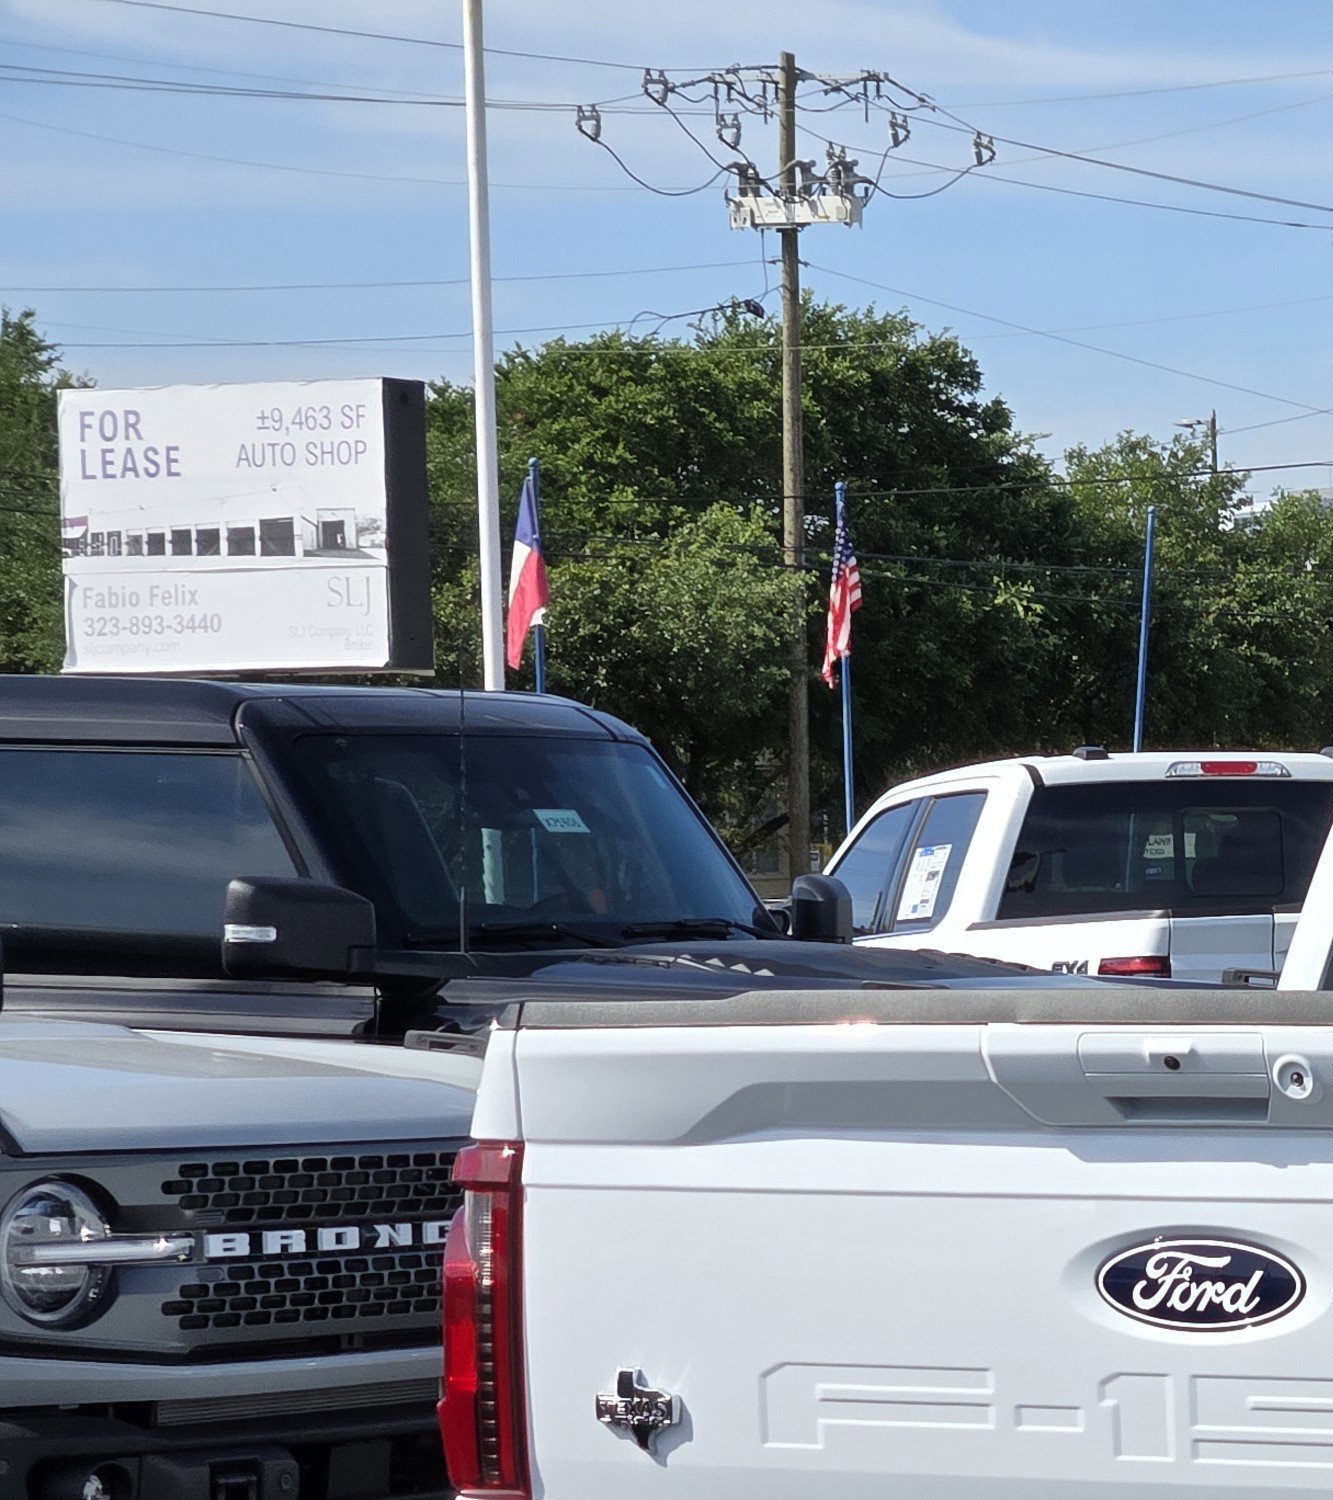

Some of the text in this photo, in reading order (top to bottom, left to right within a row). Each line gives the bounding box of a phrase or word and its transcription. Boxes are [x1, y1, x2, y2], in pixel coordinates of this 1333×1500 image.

[79, 409, 143, 443] FOR
[256, 404, 367, 436] ±9,463 SF
[80, 446, 182, 480] LEASE
[236, 439, 367, 468] AUTO SHOP
[83, 582, 199, 609] Fabio Felix
[326, 576, 371, 617] SLJ
[84, 612, 222, 638] 323-893-3440
[204, 1220, 450, 1259] BRONC
[1131, 1249, 1264, 1316] Ford
